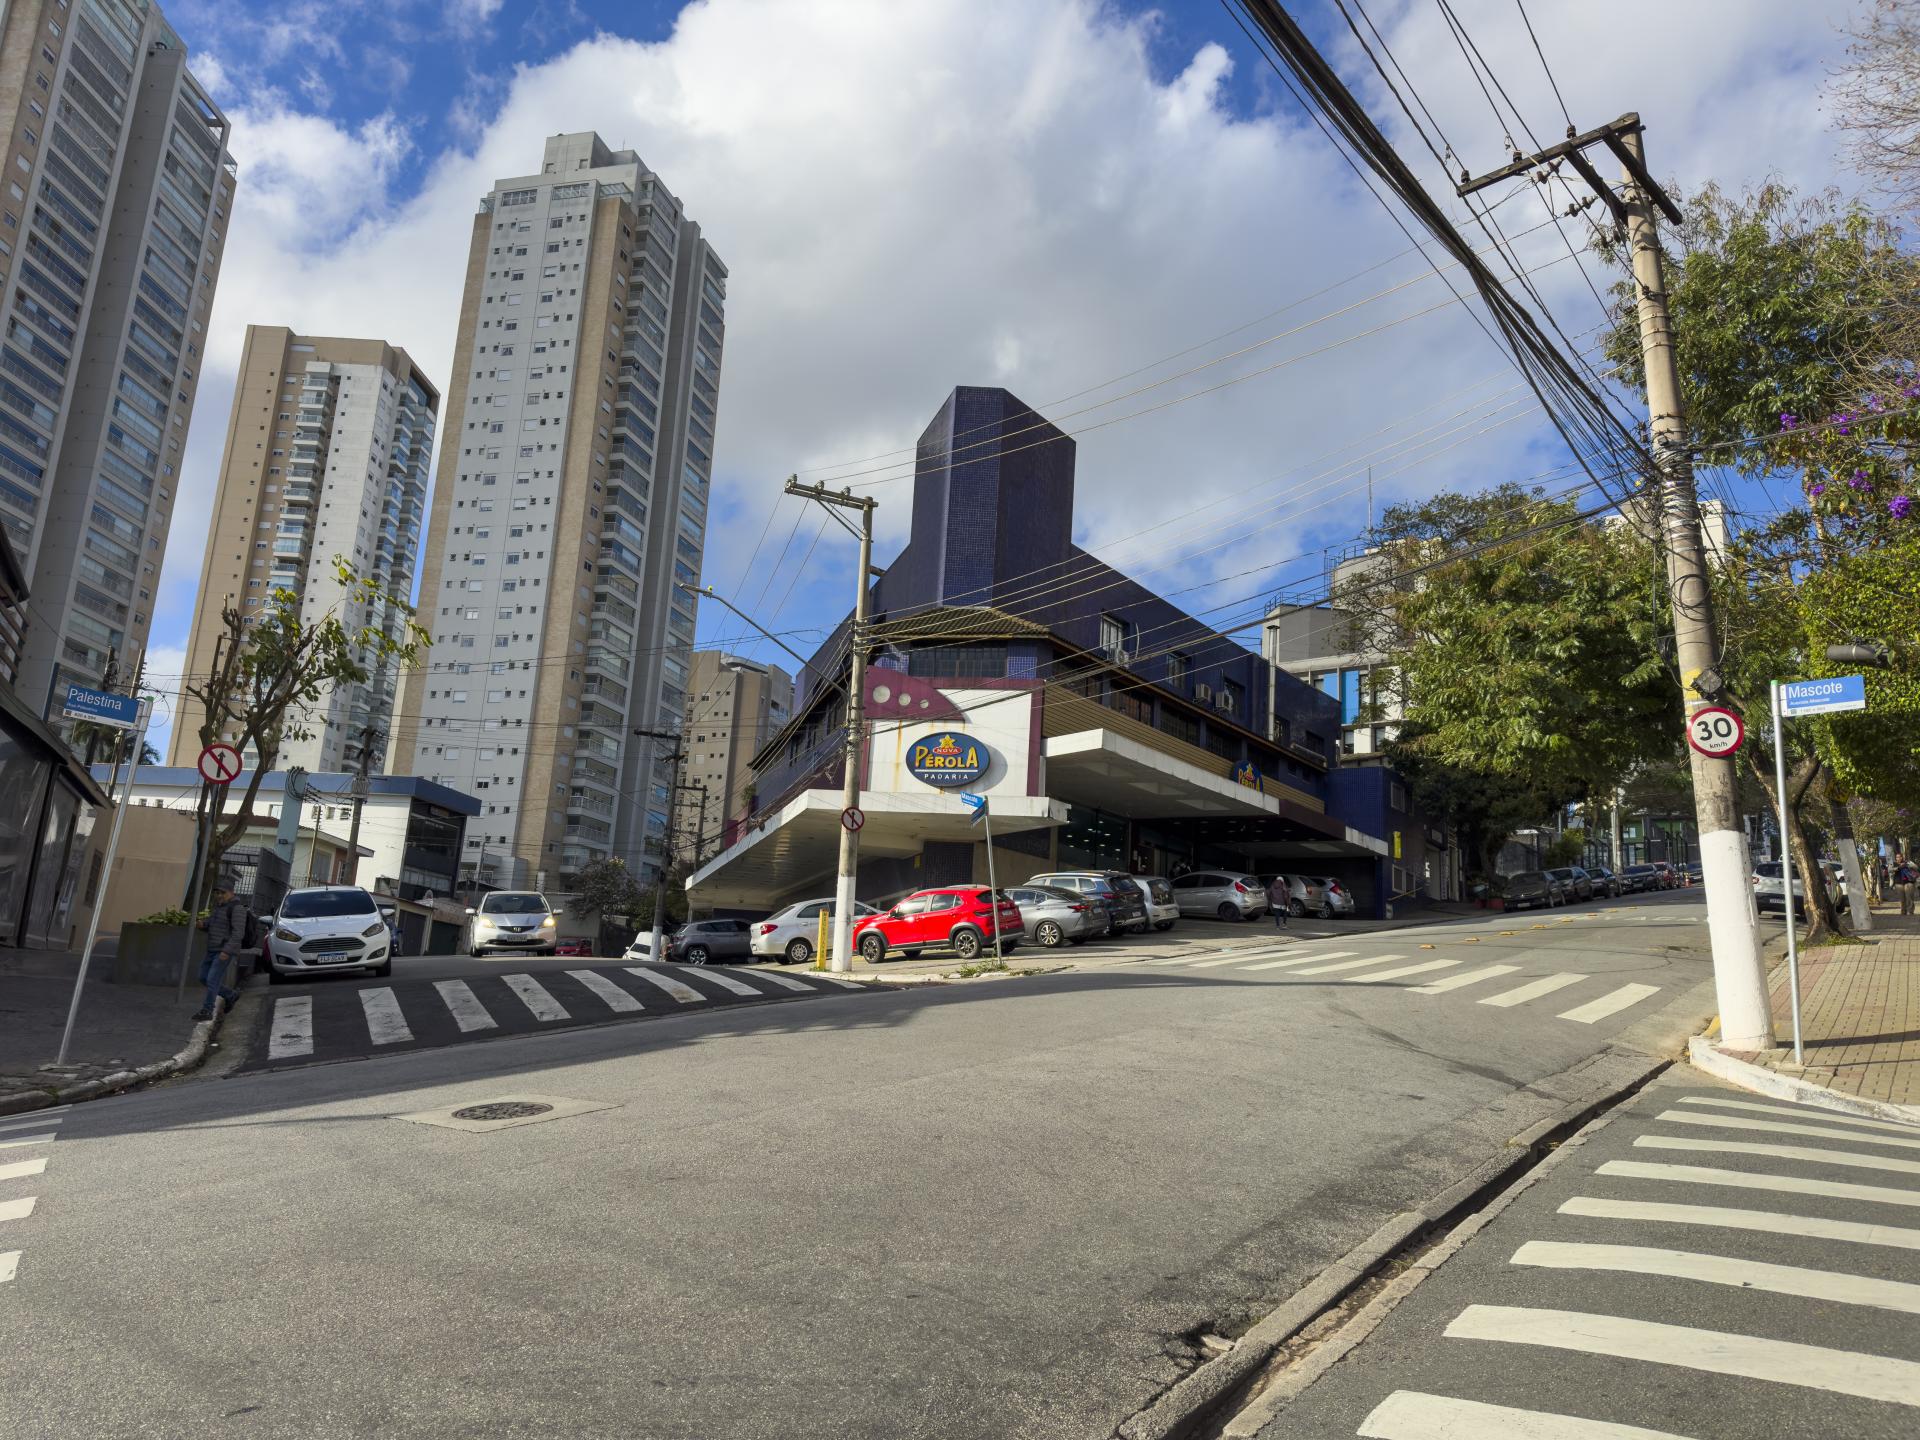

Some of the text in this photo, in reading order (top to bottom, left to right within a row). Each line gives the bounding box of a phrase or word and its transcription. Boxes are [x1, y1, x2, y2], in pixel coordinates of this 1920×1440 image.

[68, 688, 122, 710] Palestina
[1788, 681, 1843, 698] Mascote
[1697, 717, 1732, 741] 30
[915, 746, 979, 768] PÉROLA
